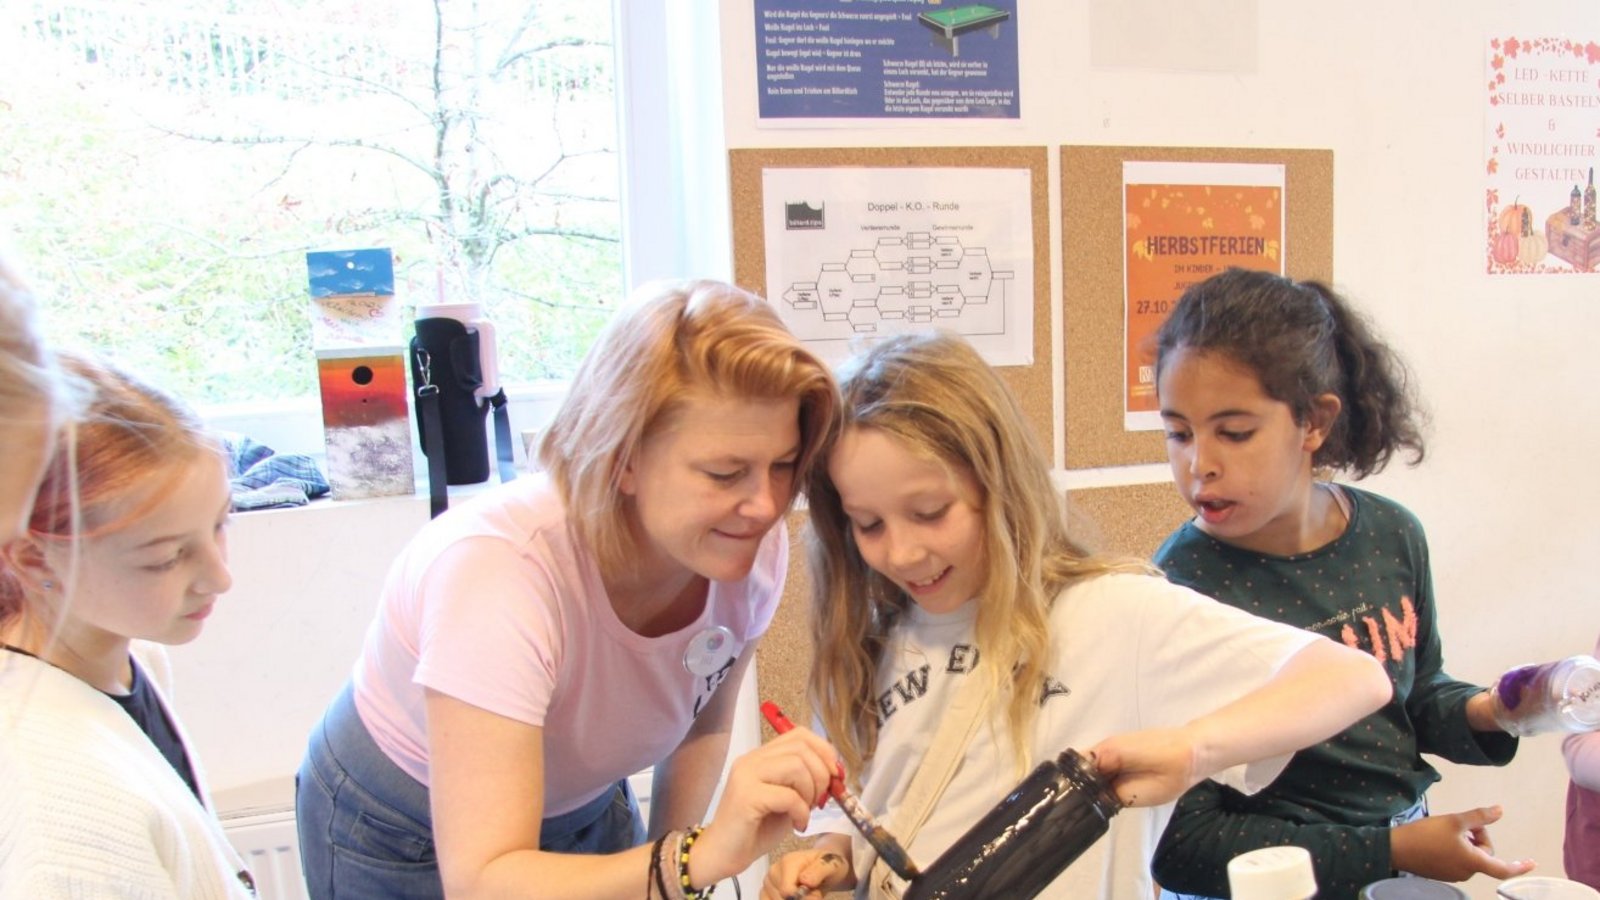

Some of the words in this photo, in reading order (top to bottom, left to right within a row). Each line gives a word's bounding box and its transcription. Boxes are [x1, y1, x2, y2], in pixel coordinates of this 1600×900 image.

[1515, 68, 1539, 81] LED
[1499, 93, 1545, 106] SELBER
[1507, 142, 1597, 157] WINDLICHTER
[1515, 167, 1587, 181] GESTALTEN
[867, 201, 898, 213] Doppel
[932, 201, 960, 211] Runde
[1147, 235, 1265, 256] HERBSTFERIEN
[1186, 264, 1214, 274] KINDER
